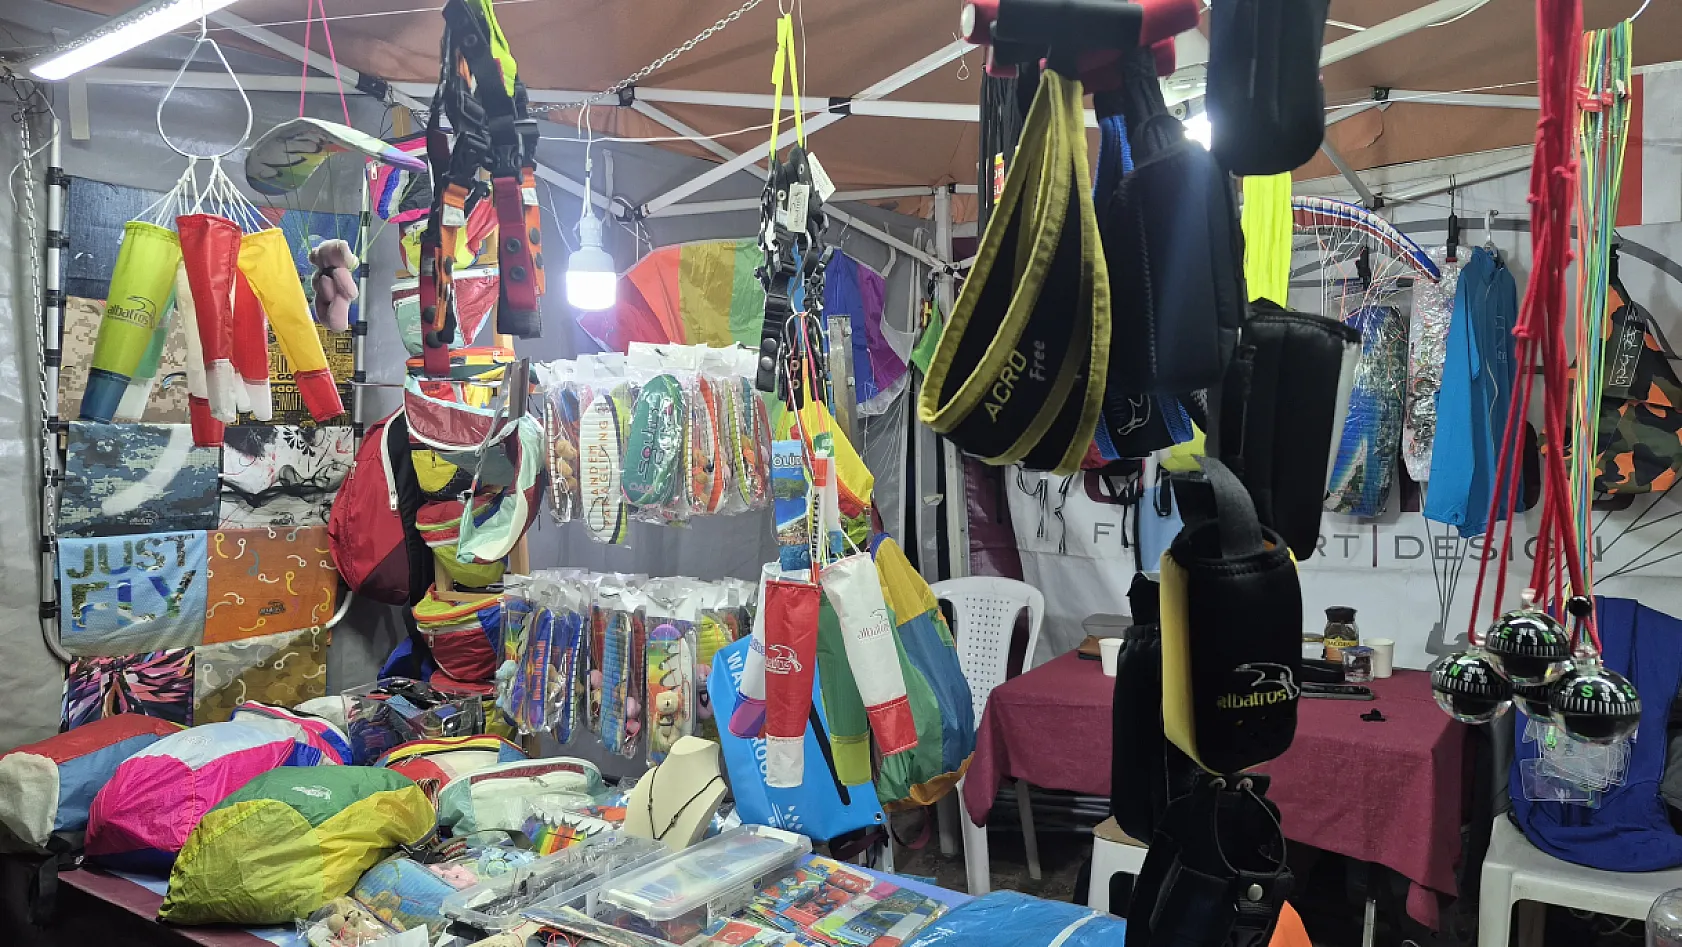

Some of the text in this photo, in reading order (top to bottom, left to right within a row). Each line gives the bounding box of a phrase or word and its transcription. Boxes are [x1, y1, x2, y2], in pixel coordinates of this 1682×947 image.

[1029, 340, 1046, 381] Free
[985, 348, 1027, 423] ACRO
[66, 533, 195, 579] JUST
[1315, 534, 1360, 559] RT
[71, 569, 197, 632] FLY
[1449, 663, 1462, 677] N
[1217, 688, 1287, 708] albatros
[1580, 684, 1594, 698] S
